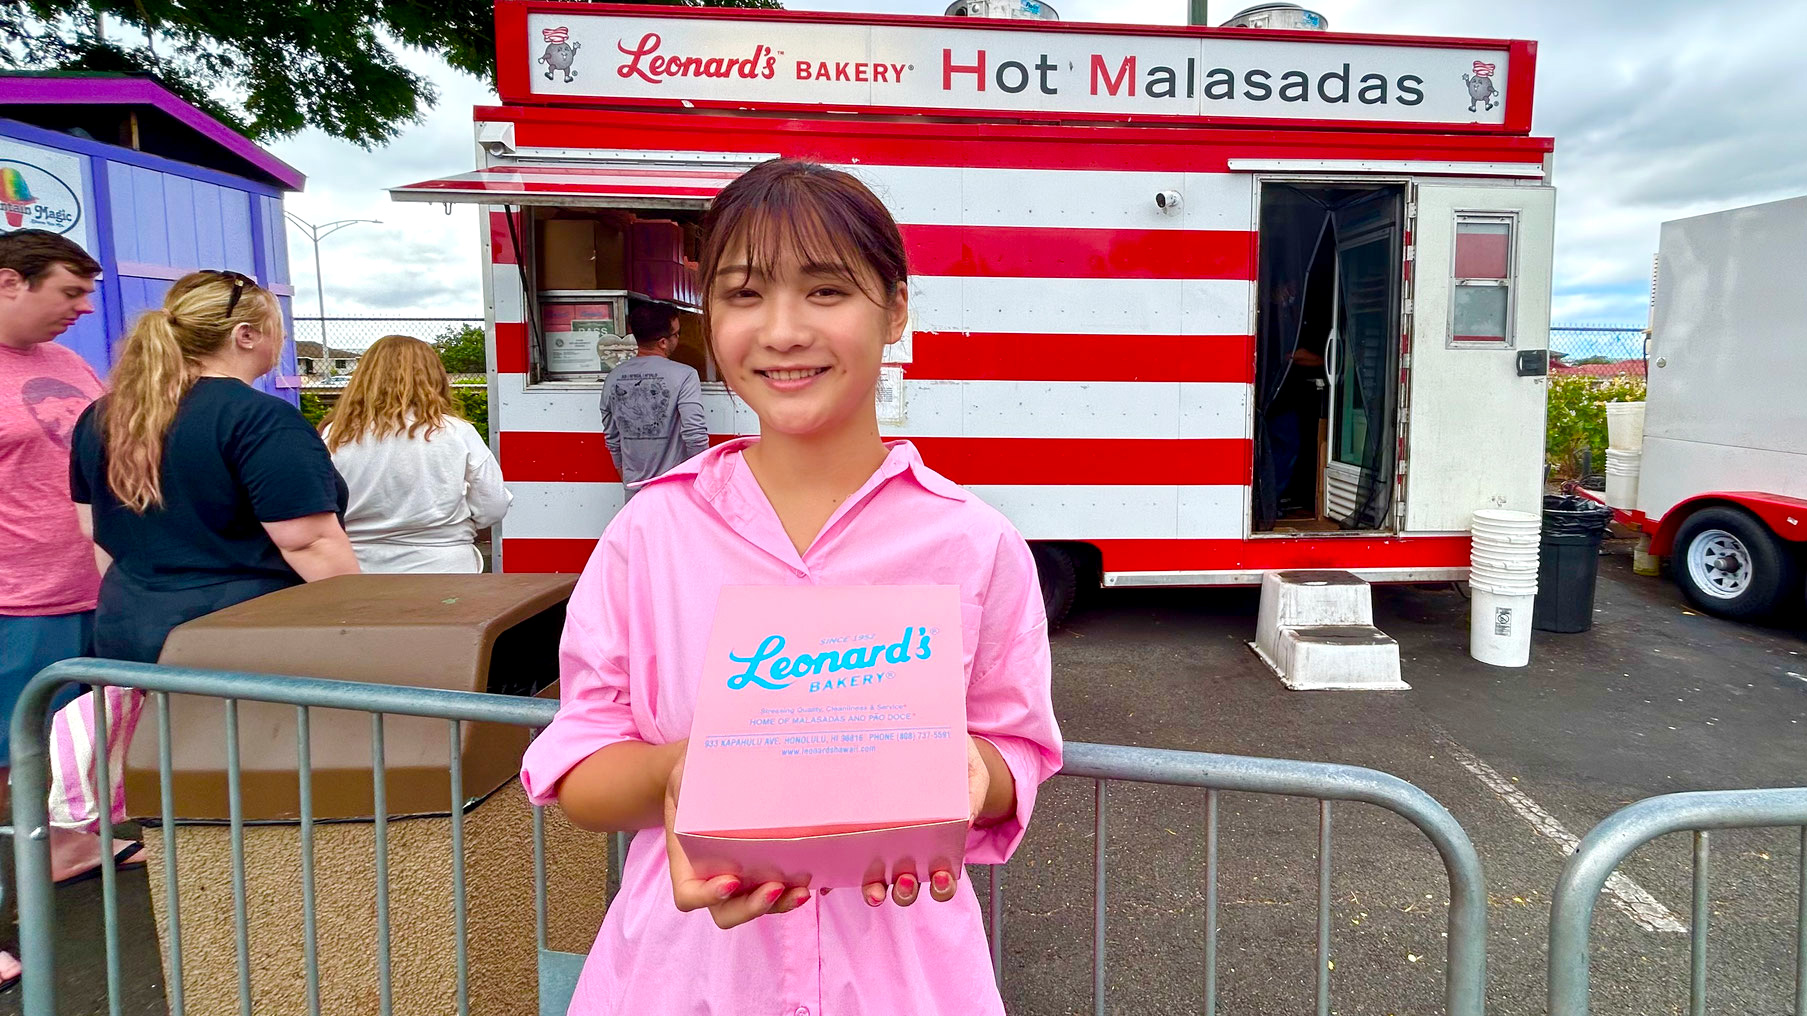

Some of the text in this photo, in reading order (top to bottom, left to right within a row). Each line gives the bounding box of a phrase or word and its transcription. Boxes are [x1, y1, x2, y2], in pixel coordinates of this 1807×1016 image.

[942, 48, 1058, 95] Hot
[1090, 53, 1426, 107] Malasadas
[34, 205, 72, 222] Magic
[820, 637, 848, 645] SINCE
[750, 718, 775, 726] HOME
[792, 715, 846, 724] MALASADAS
[704, 739, 719, 748] 933
[721, 738, 762, 747] KAPAHULU
[869, 732, 895, 741] PHONE
[897, 732, 916, 742] (808)
